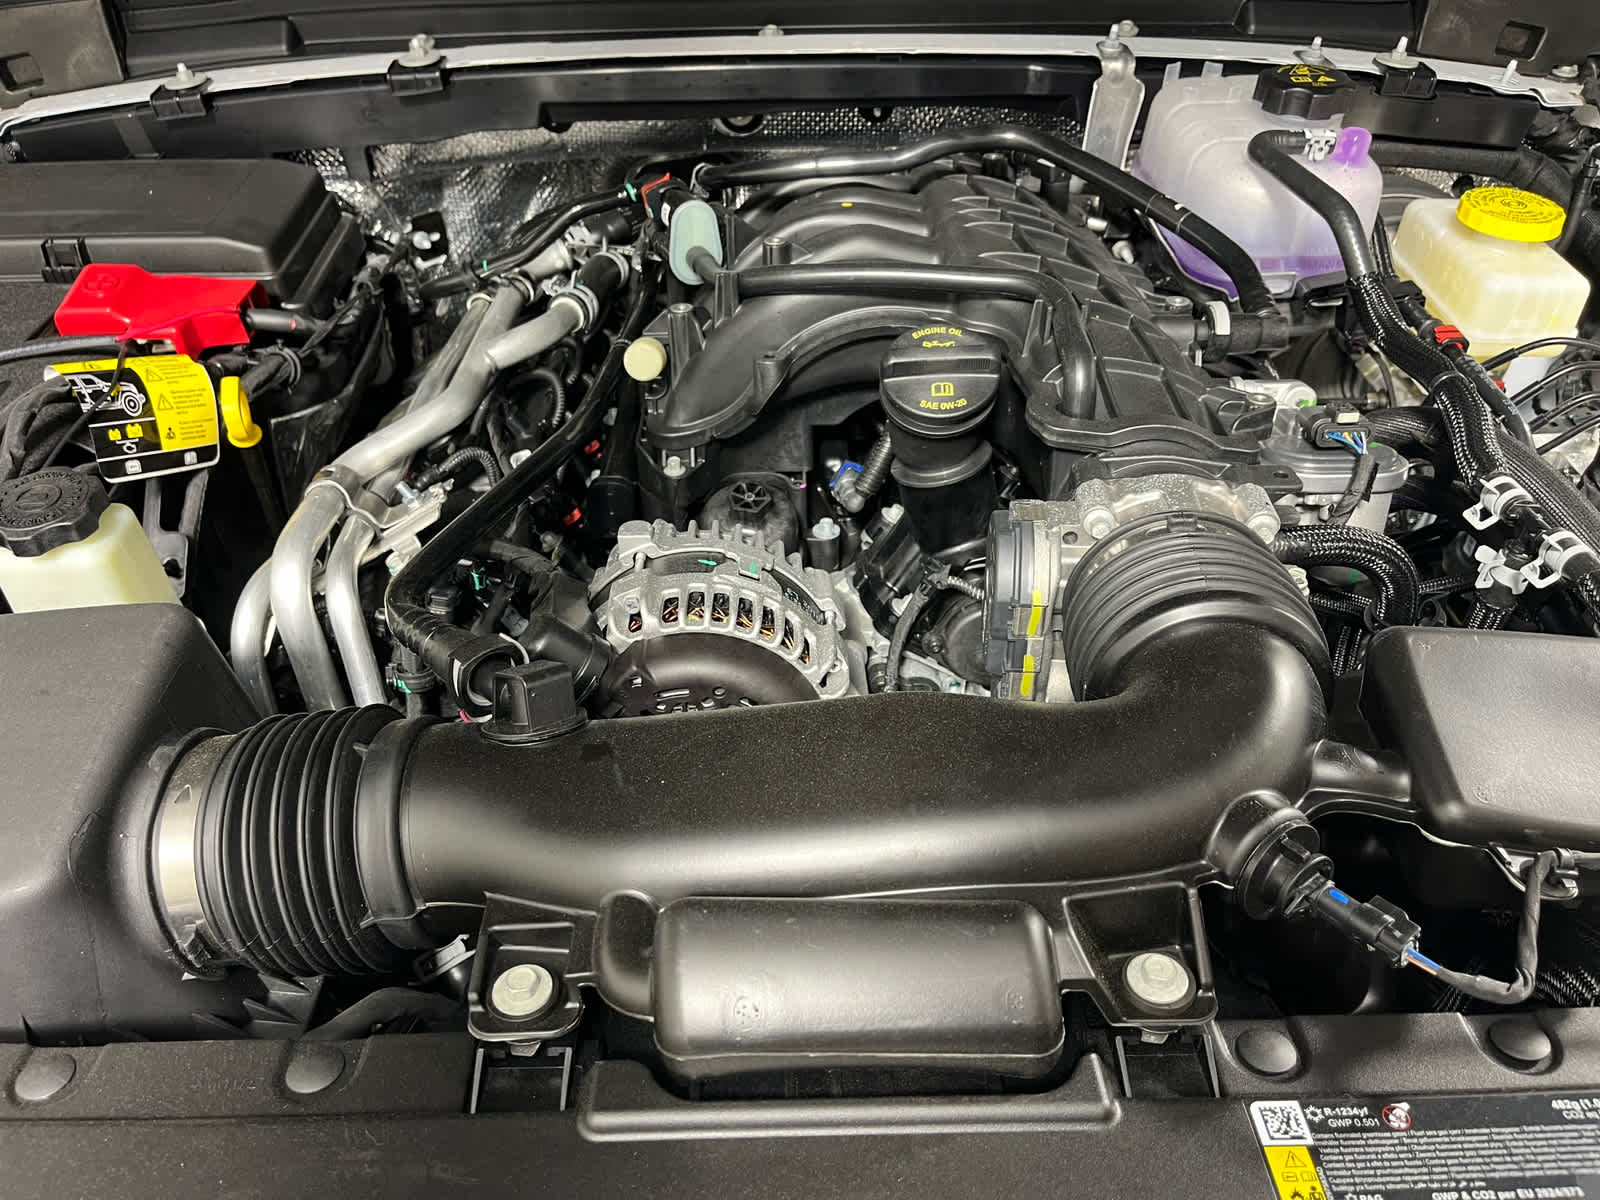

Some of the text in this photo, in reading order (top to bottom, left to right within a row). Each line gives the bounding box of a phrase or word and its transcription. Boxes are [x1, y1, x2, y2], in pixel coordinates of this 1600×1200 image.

[912, 327, 962, 339] ENGINE OIL
[920, 398, 967, 410] SAE 0W-20
[1323, 1106, 1368, 1117] R-1234yf
[1327, 1117, 1380, 1127] GWP 0.501
[1432, 1191, 1459, 1200] GWP
[1472, 1189, 1497, 1200] CO2
[1517, 1188, 1535, 1199] EU
